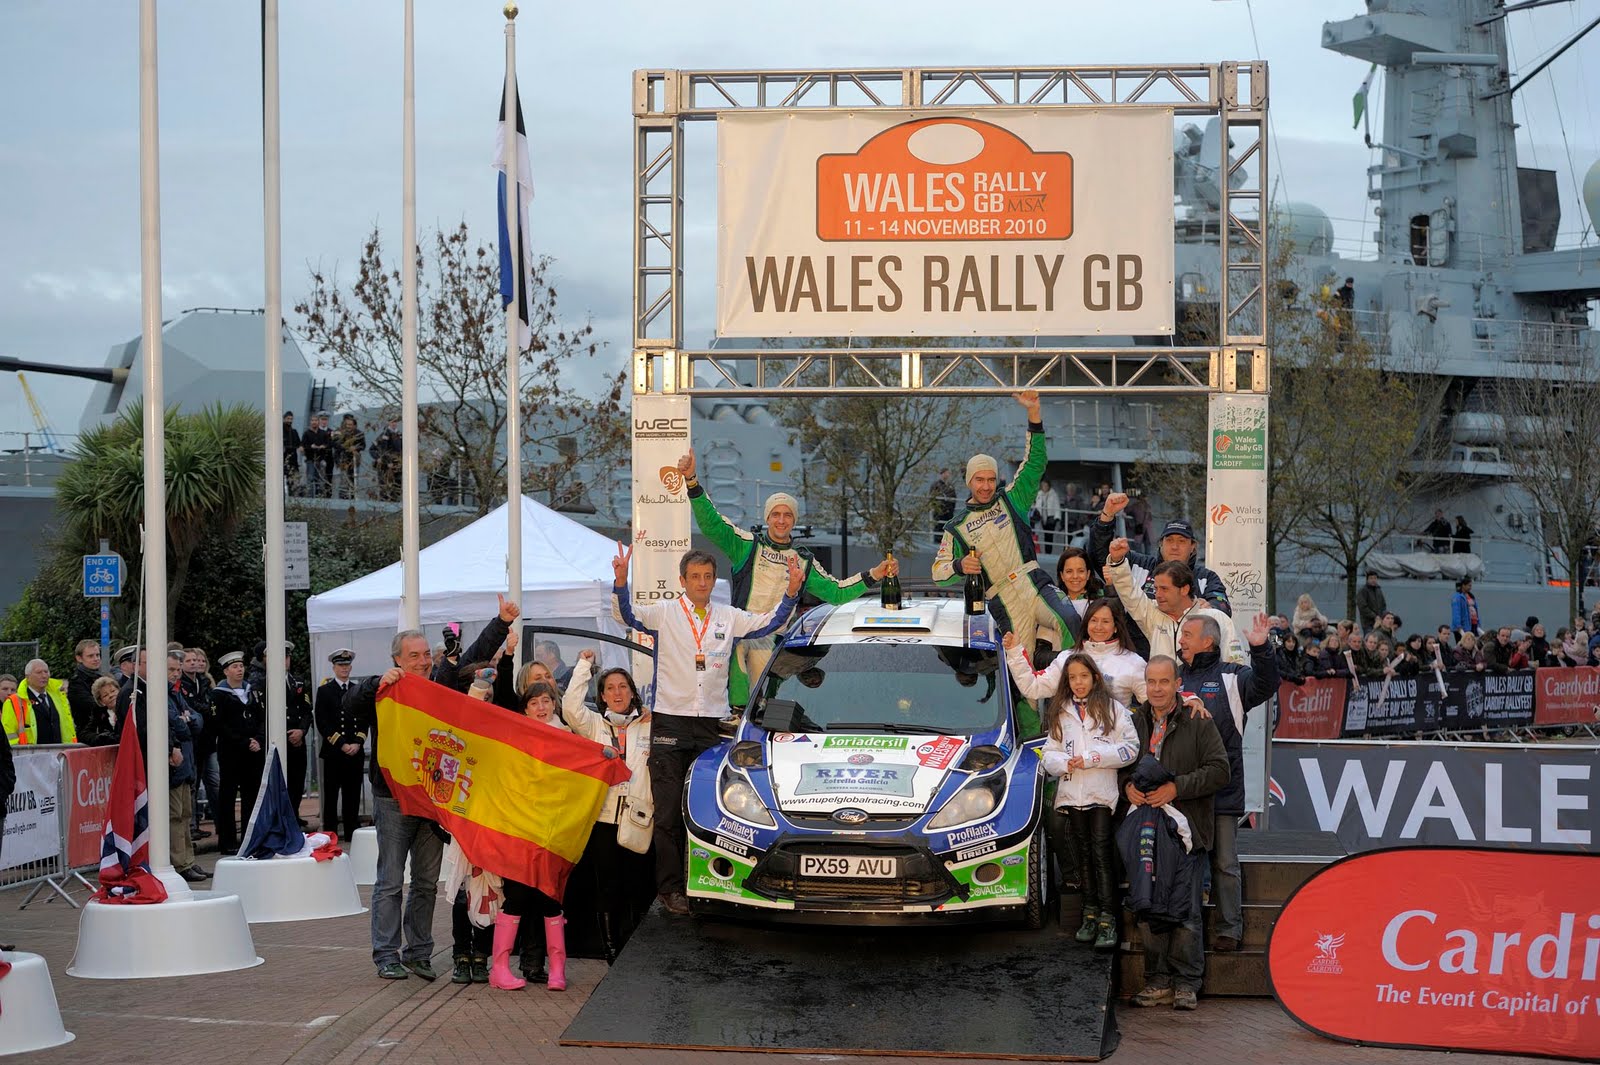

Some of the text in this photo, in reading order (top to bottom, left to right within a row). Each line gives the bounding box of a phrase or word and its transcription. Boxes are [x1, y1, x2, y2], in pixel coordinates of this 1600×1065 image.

[844, 171, 1047, 213] WALES RALLY
[973, 193, 1046, 213] GB MSA
[844, 219, 861, 235] 11
[879, 219, 900, 235] 14
[904, 219, 1001, 235] NOVEMBER
[1005, 219, 1047, 235] 2010
[745, 253, 1144, 313] WALES RALLY GB
[635, 418, 688, 430] WRC
[1234, 444, 1252, 453] Rally
[1235, 506, 1262, 515] Wales
[1235, 515, 1265, 526] Cymru
[645, 538, 688, 549] easynet
[86, 558, 117, 566] END OF
[635, 591, 687, 600] EDOX
[1367, 680, 1390, 700] WALS
[1485, 675, 1534, 694] WALES RALLY GB
[1288, 687, 1334, 713] Cardiff
[1484, 695, 1505, 711] CARDIFF
[1504, 695, 1533, 710] RALLYFEST
[829, 737, 904, 747] Soriadersil
[816, 768, 898, 780] RIVER
[76, 768, 112, 807] Caer
[27, 790, 37, 810] GB
[780, 796, 926, 810] www.nupelglobalracing.com
[839, 811, 861, 822] Ford
[715, 835, 748, 856] PIRELLI
[956, 840, 998, 862] PIRELLI
[804, 857, 894, 876] PX59 AVU
[1375, 983, 1411, 1005] The
[1417, 986, 1475, 1009] Event
[1481, 990, 1558, 1017] Capital
[1564, 995, 1590, 1016] of
